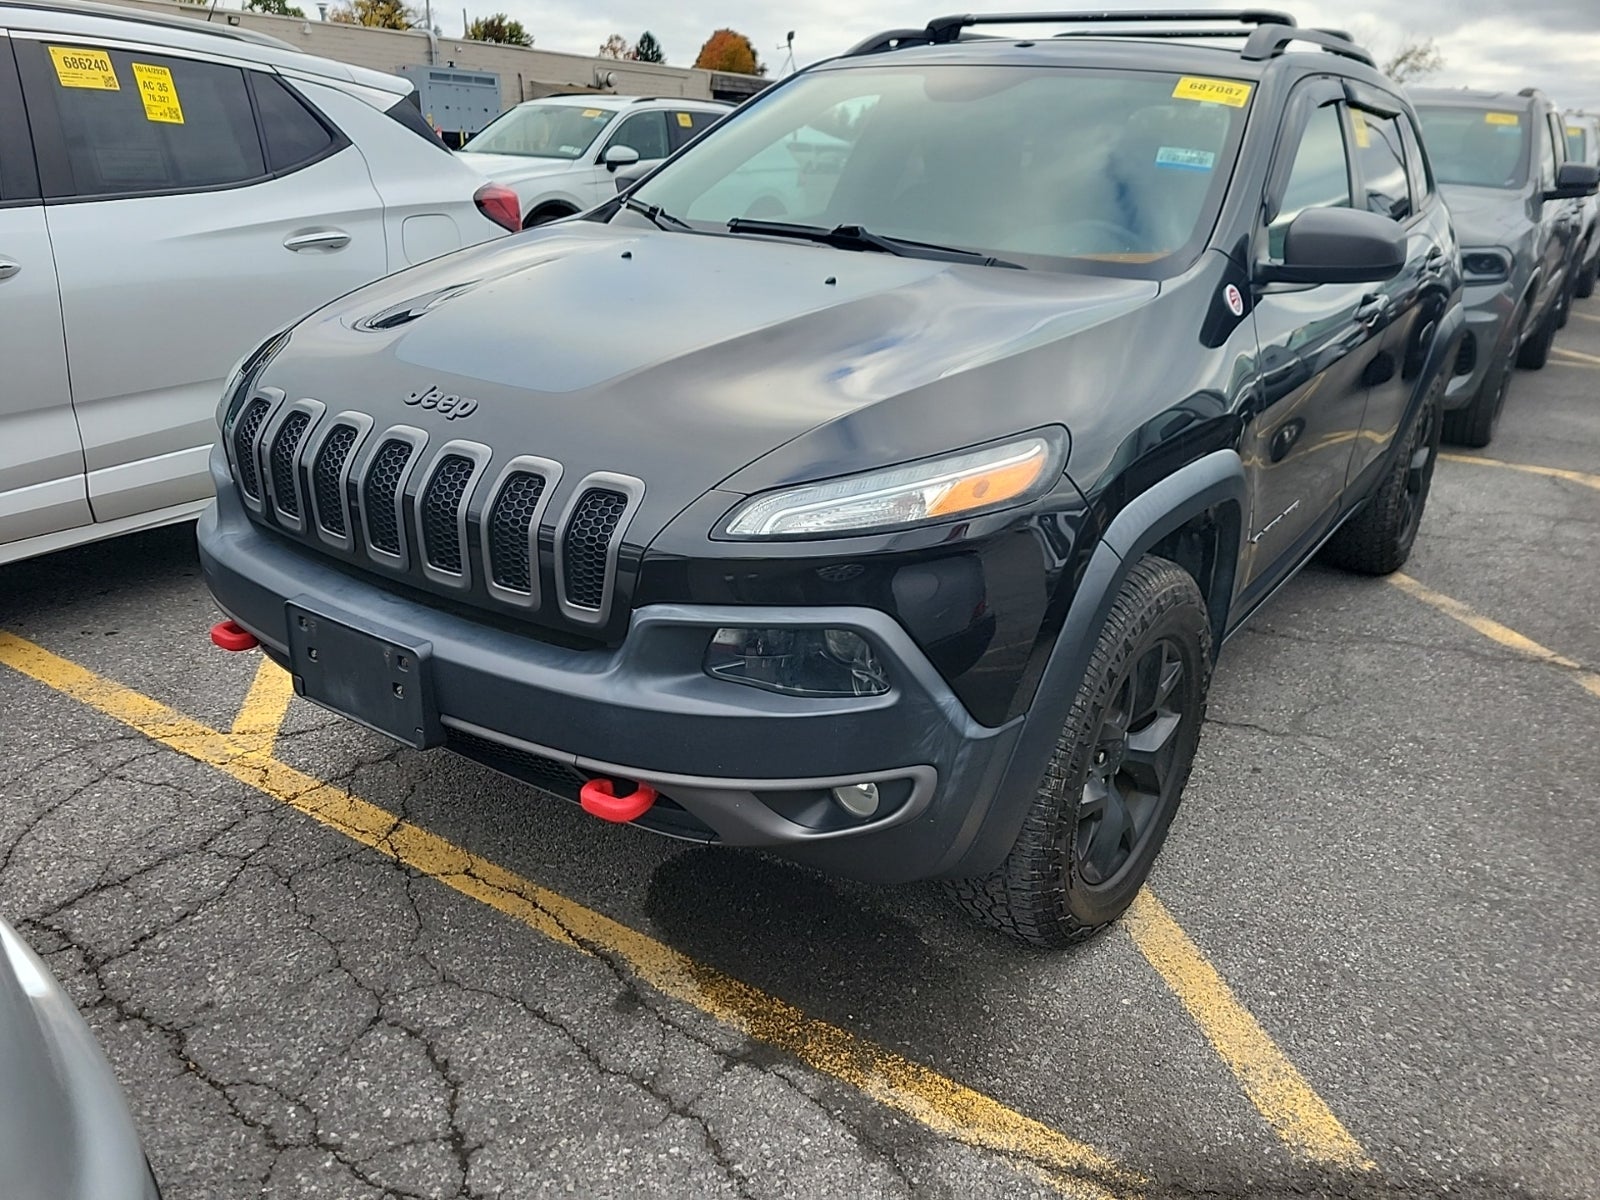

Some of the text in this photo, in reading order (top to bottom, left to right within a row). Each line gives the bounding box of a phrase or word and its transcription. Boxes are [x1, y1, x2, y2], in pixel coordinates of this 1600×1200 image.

[63, 56, 109, 72] 686240
[142, 80, 169, 93] AC 35
[1189, 82, 1243, 96] 687087
[403, 385, 479, 421] Jeep
